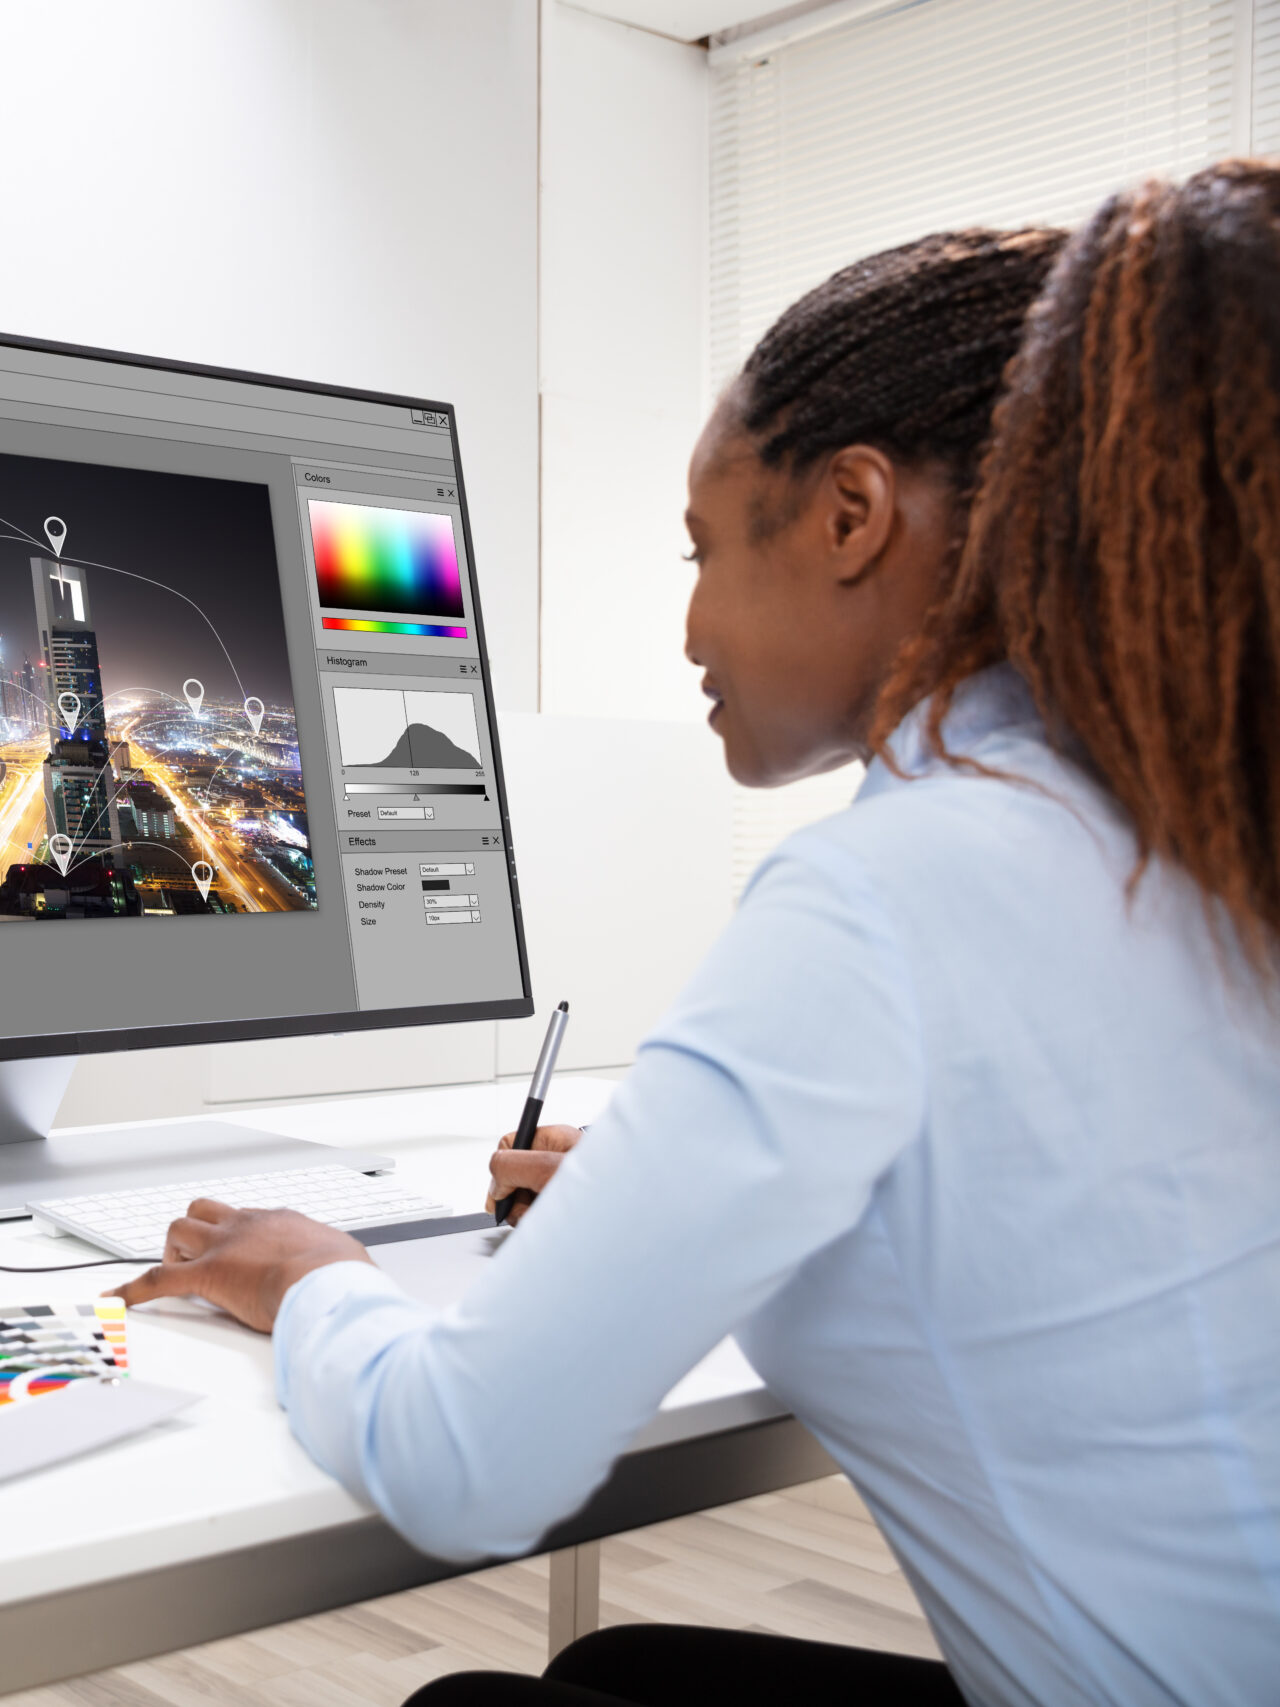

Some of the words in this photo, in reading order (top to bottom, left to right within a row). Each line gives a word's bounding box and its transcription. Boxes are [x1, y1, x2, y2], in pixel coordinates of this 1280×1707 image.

[304, 472, 331, 484] Colors
[326, 656, 368, 668] Histogram
[347, 809, 372, 818] Preset
[348, 837, 377, 847] Effects
[354, 867, 384, 877] Shadow
[384, 867, 408, 876] Preset
[356, 883, 385, 892] Shadow
[386, 882, 406, 891] Color
[358, 900, 385, 910] Density
[360, 917, 377, 926] Size
